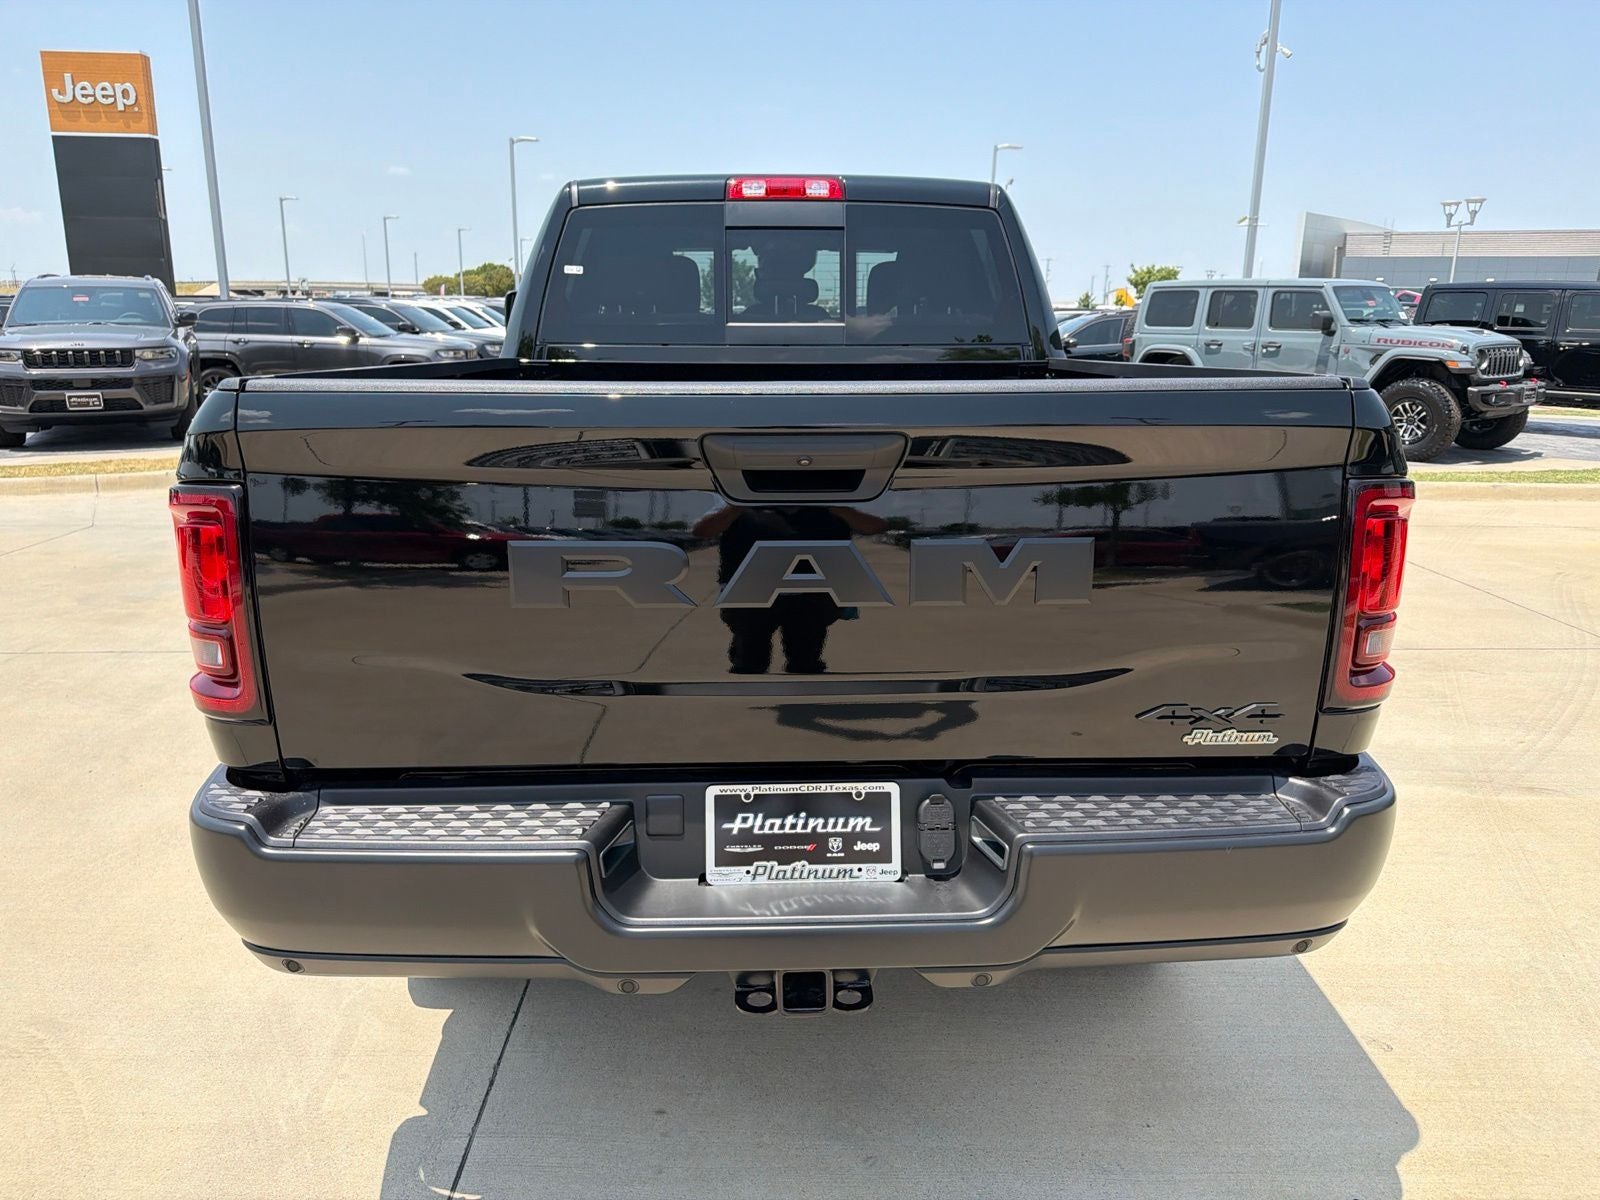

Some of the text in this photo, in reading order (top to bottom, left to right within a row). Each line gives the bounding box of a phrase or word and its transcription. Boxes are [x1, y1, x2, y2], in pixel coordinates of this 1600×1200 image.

[51, 73, 137, 111] Jeep
[1376, 338, 1454, 348] RUBICON
[507, 537, 1095, 608] RAM
[1182, 728, 1278, 745] Platinum
[719, 784, 885, 794] www.PlatinumCDRJTexas.com
[722, 811, 883, 835] Platinum
[853, 840, 880, 853] Jeep
[750, 863, 861, 882] Platinum
[879, 868, 899, 876] Jeep
